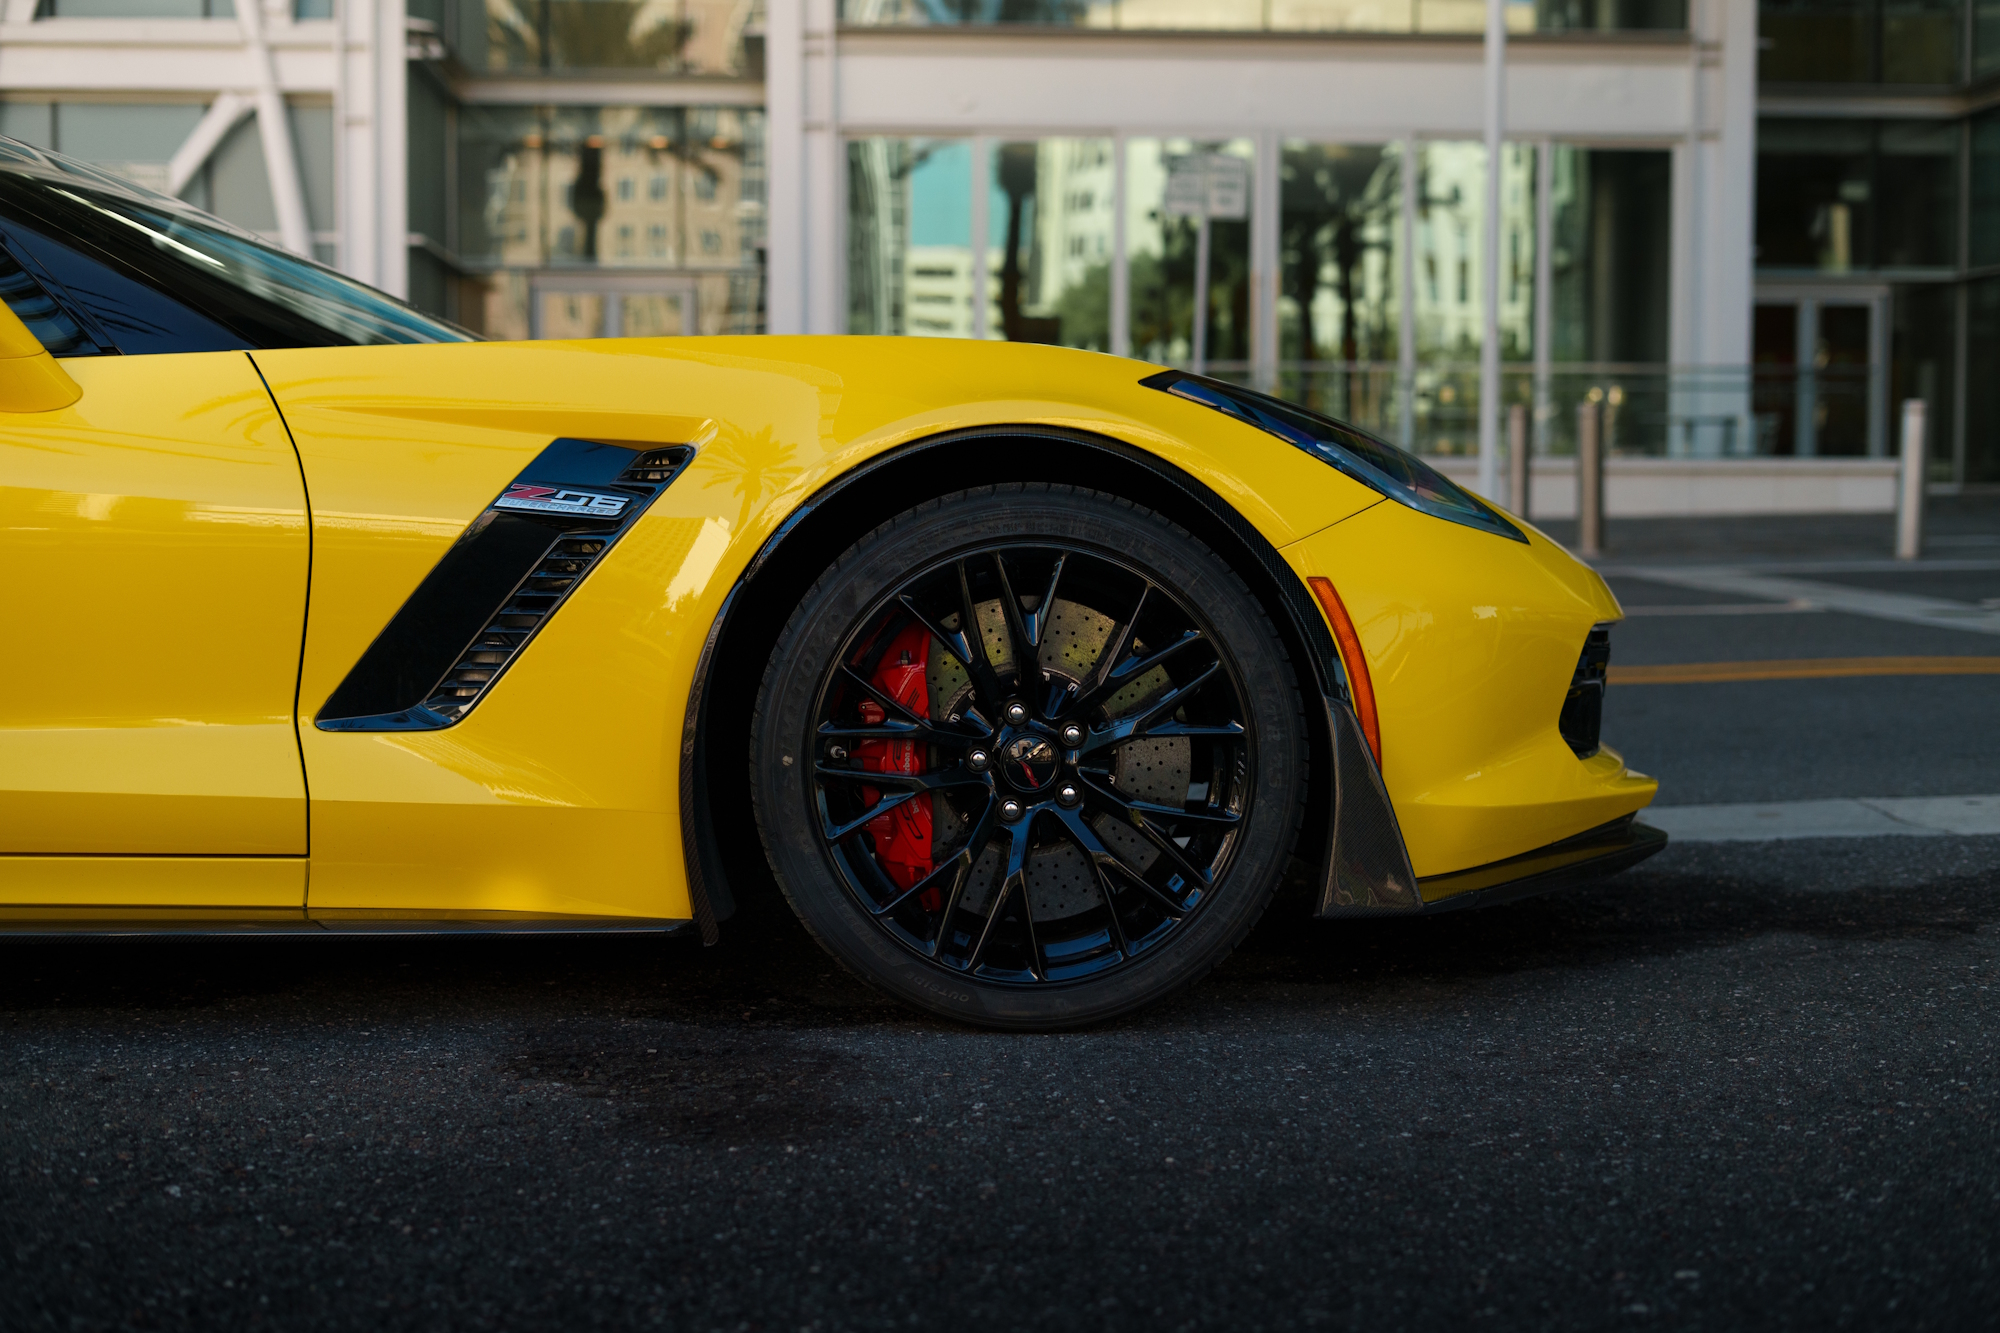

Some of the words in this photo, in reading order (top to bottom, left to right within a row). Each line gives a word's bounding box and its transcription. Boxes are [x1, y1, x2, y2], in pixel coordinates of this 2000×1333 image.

[499, 498, 616, 514] SUPERCHARGED
[502, 483, 630, 509] Z06
[903, 970, 969, 1002] OUTSIDE
